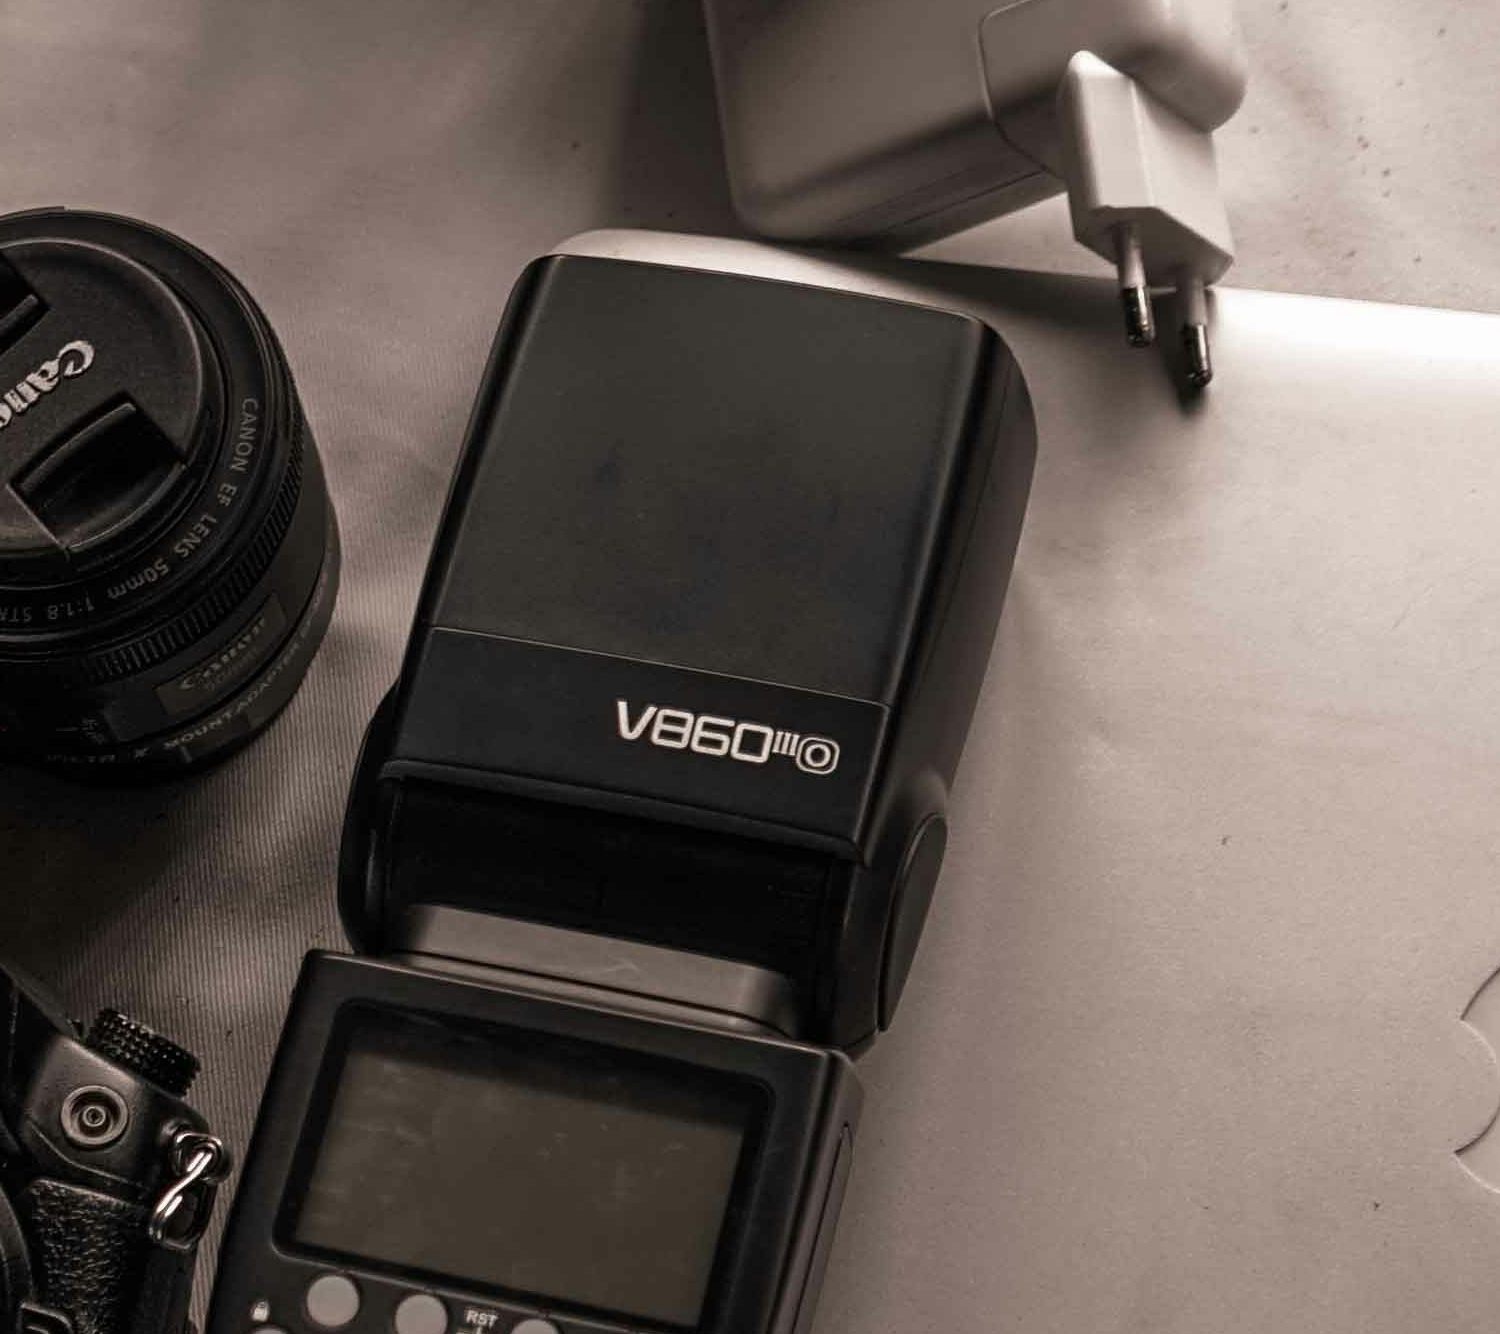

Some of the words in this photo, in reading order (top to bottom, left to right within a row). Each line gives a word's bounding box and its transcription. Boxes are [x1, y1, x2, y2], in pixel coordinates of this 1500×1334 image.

[230, 397, 257, 476] CANON
[219, 482, 239, 507] EF
[176, 514, 218, 560] LENS
[103, 558, 171, 599] 50mm
[48, 597, 97, 622] 1:1.8
[466, 1310, 497, 1325] RST
